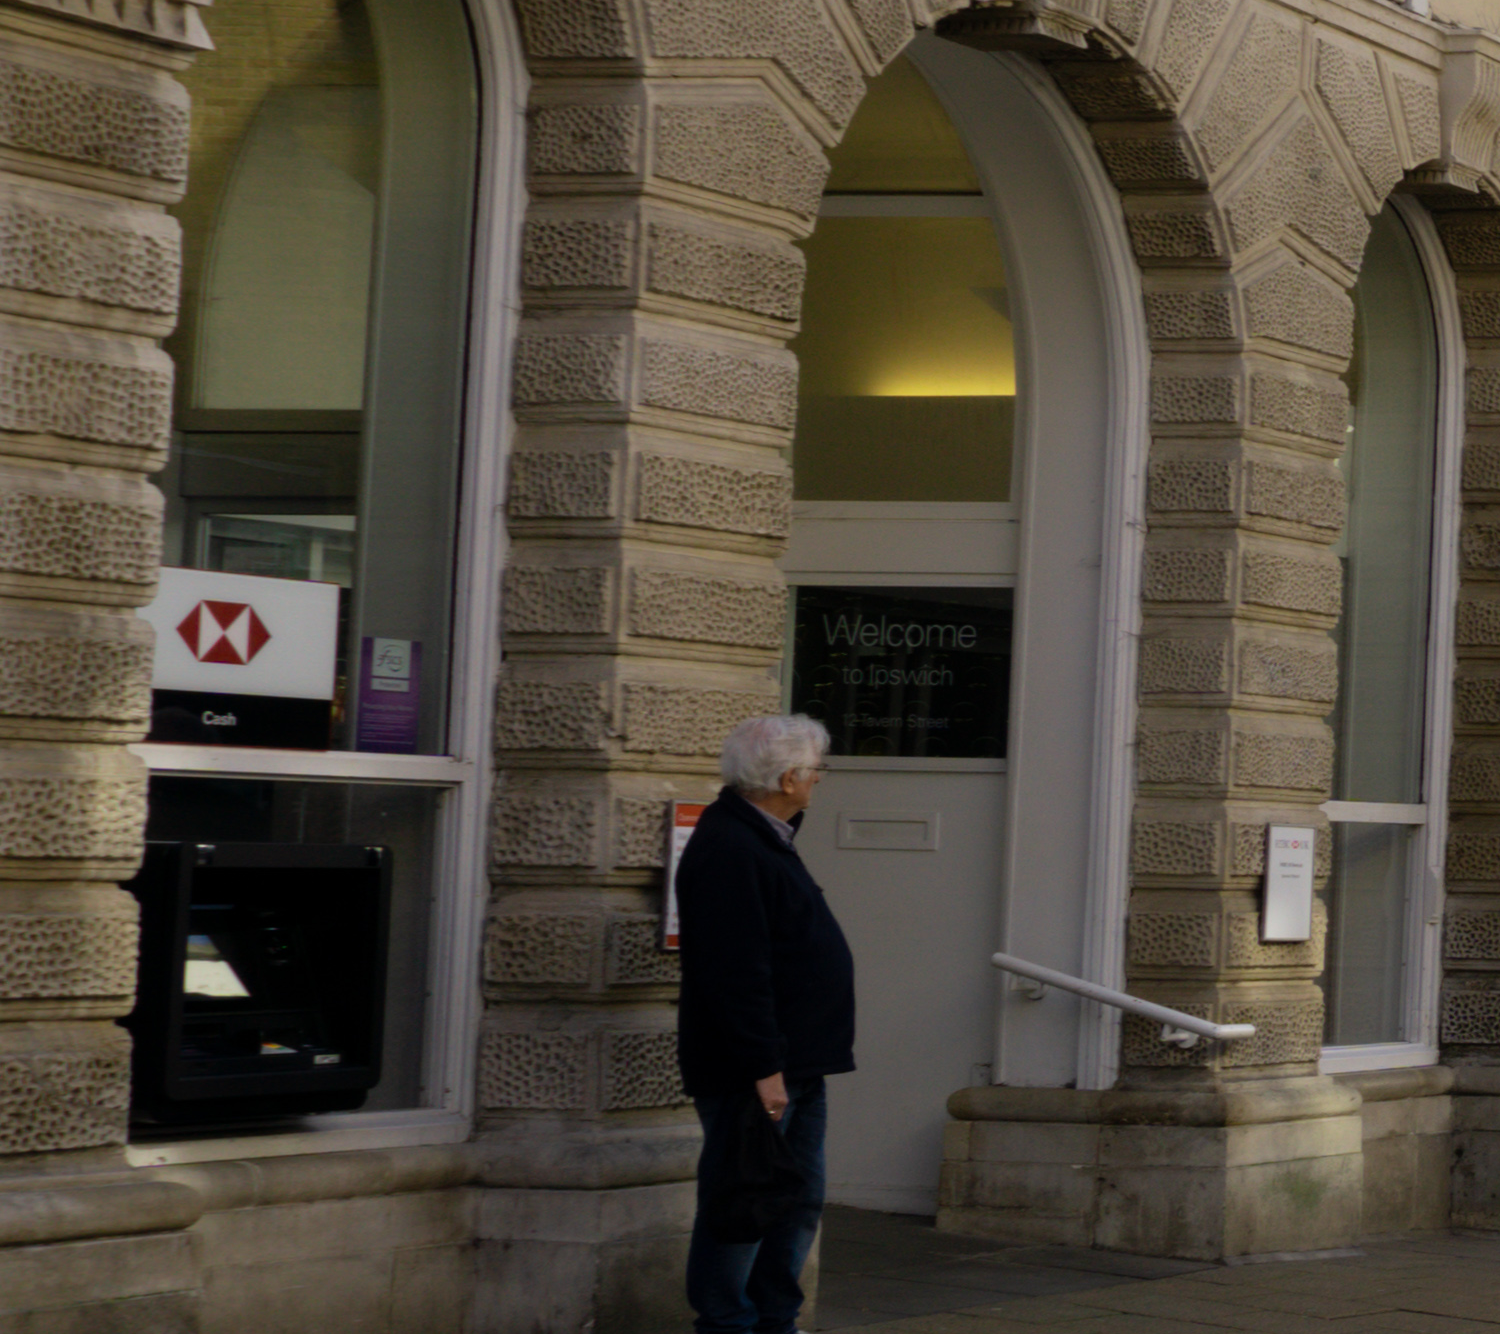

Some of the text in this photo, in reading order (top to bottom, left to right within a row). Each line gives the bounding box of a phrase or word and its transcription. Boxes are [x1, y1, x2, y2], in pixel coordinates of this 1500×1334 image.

[822, 613, 978, 649] Welcome
[842, 663, 954, 689] to Ipswich
[202, 710, 237, 726] Cash
[860, 713, 903, 728] Tavern
[907, 713, 950, 729] Street
